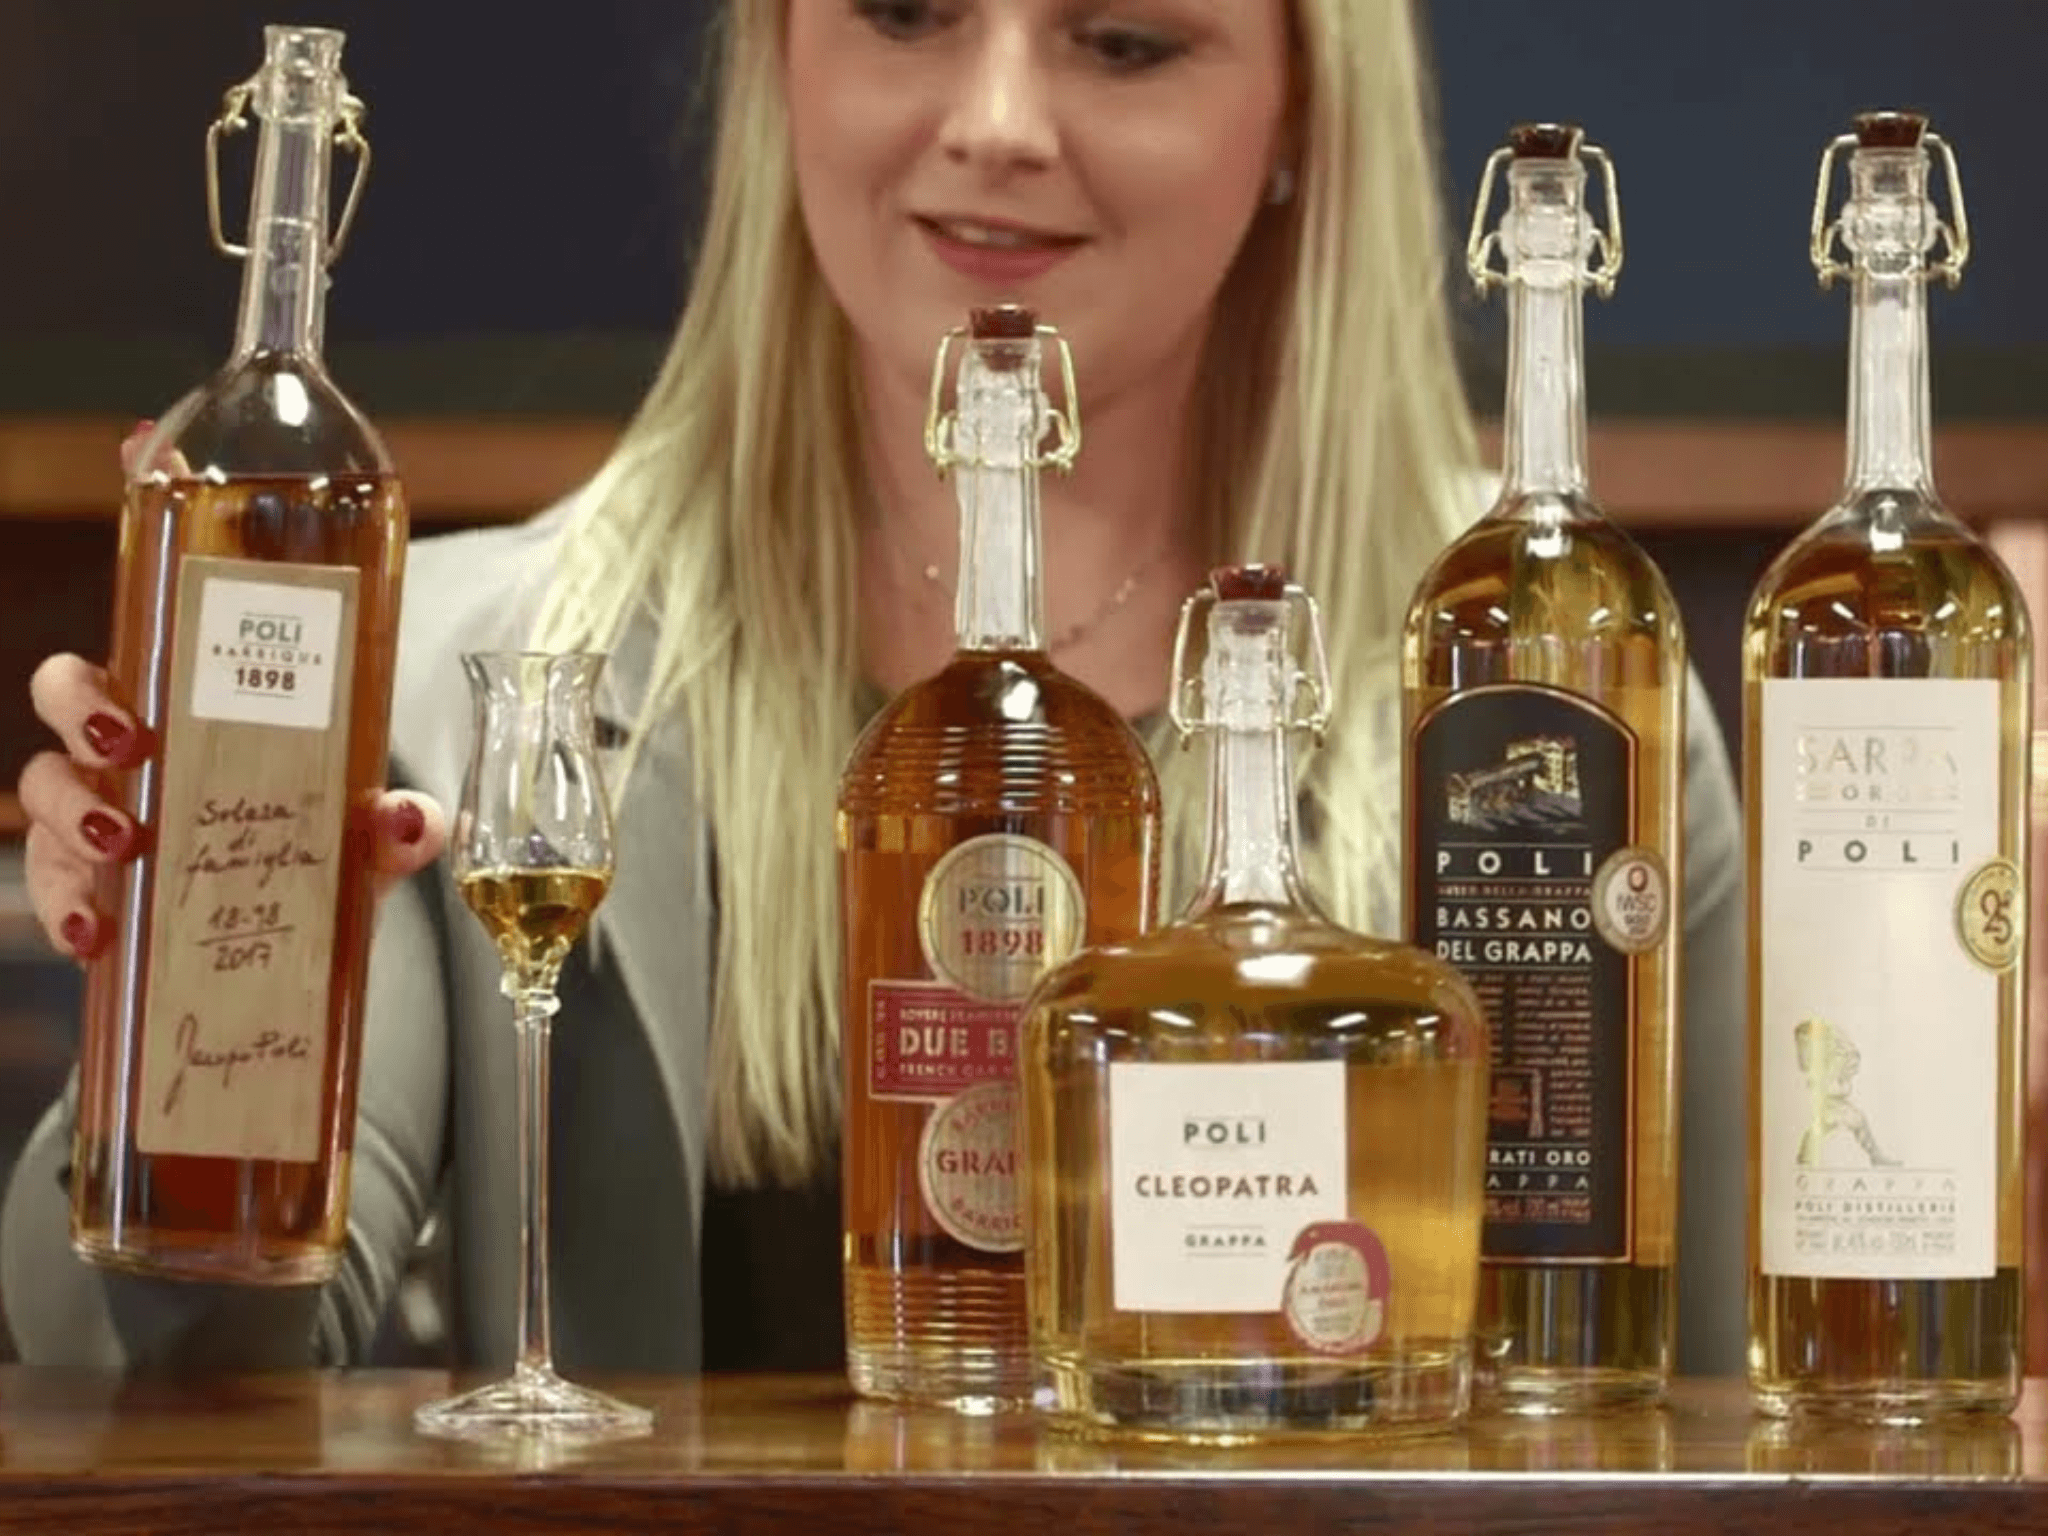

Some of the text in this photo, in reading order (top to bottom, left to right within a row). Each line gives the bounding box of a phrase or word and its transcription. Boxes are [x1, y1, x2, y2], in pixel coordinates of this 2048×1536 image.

[239, 617, 302, 644] POLI
[235, 667, 296, 692] 1898
[1436, 850, 1592, 876] POLI
[1797, 840, 1959, 864] POLI
[960, 886, 1044, 914] POLI
[1436, 906, 1592, 930] BASSANO
[962, 930, 1044, 956] 1898
[1436, 940, 1592, 963] DEL GRAPPA
[213, 941, 273, 972] 2017
[900, 1026, 971, 1058] DUE
[1184, 1121, 1266, 1144] POLI
[1546, 1149, 1591, 1166] ORO
[1135, 1174, 1319, 1198] CLEOPATRA
[1184, 1232, 1266, 1248] GRAPPA
